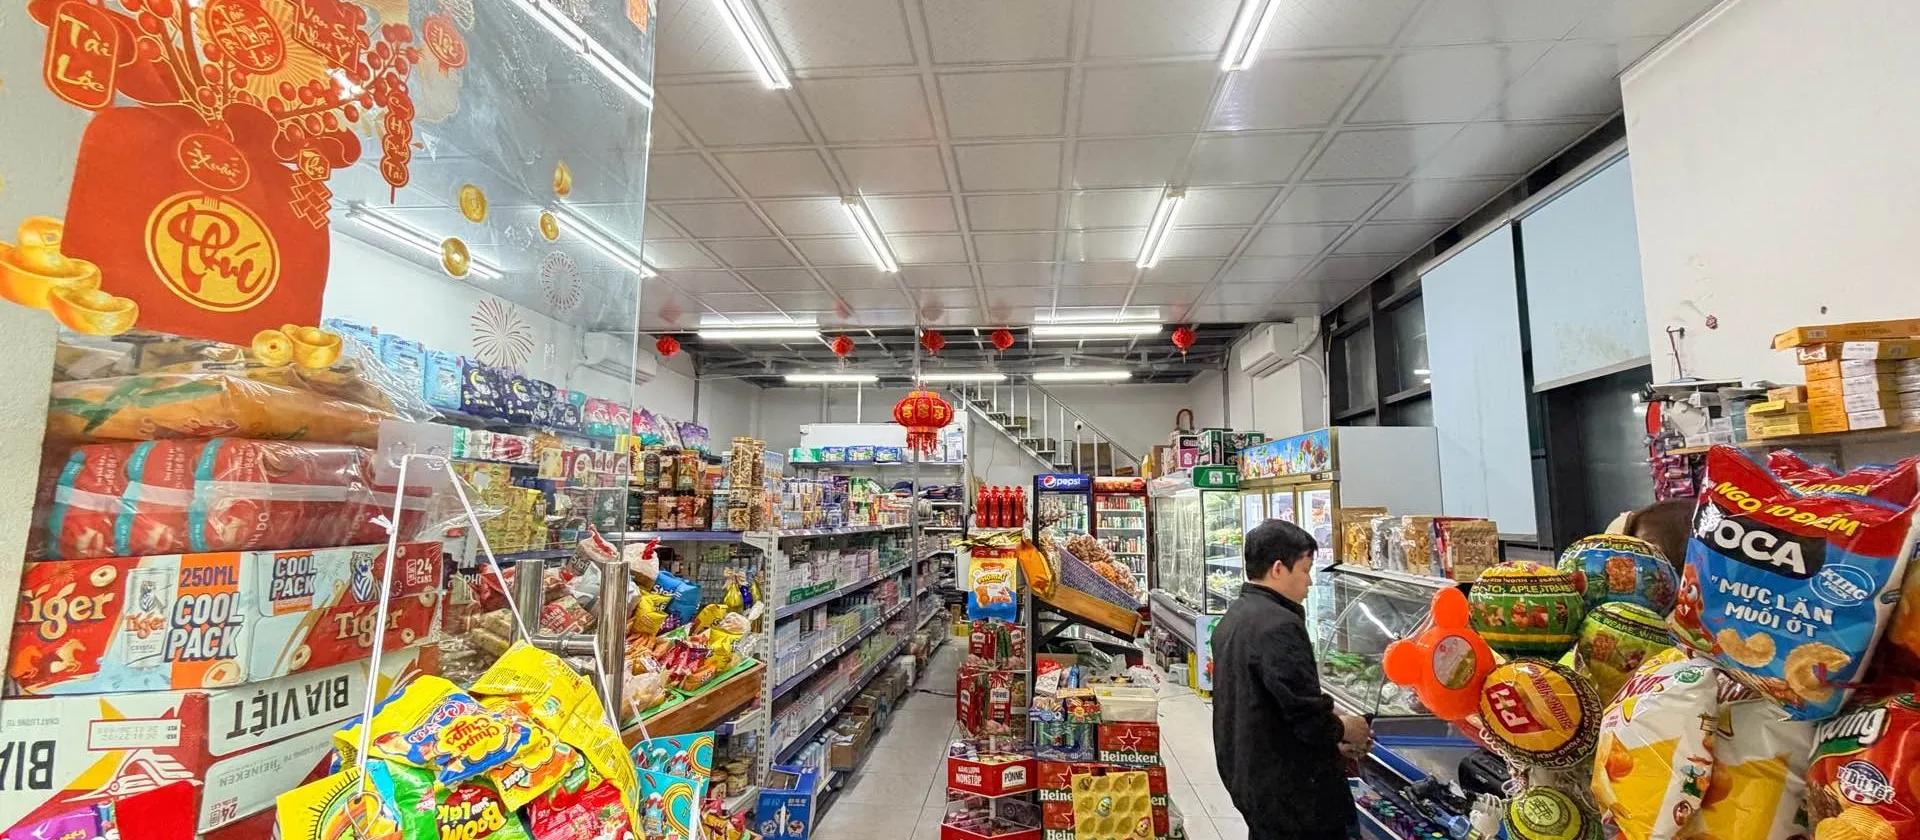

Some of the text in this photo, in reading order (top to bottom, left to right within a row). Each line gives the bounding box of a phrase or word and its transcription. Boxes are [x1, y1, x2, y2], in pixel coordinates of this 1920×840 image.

[60, 13, 111, 57] Tài
[56, 54, 105, 93] Lộc
[180, 566, 239, 588] 250ML
[274, 555, 317, 579] COOL
[416, 558, 433, 576] 24
[270, 574, 316, 602] PACK
[1719, 580, 1771, 606] MỰC
[172, 591, 245, 627] COOL
[1725, 602, 1781, 630] MUỐI
[335, 605, 404, 648] Tigr
[164, 624, 243, 663] PACK
[226, 674, 349, 740] BIA VIỆT
[1492, 686, 1531, 729] PH
[1100, 750, 1158, 764] Heineken
[1040, 790, 1073, 802] Heine
[1047, 830, 1075, 840] Hein
